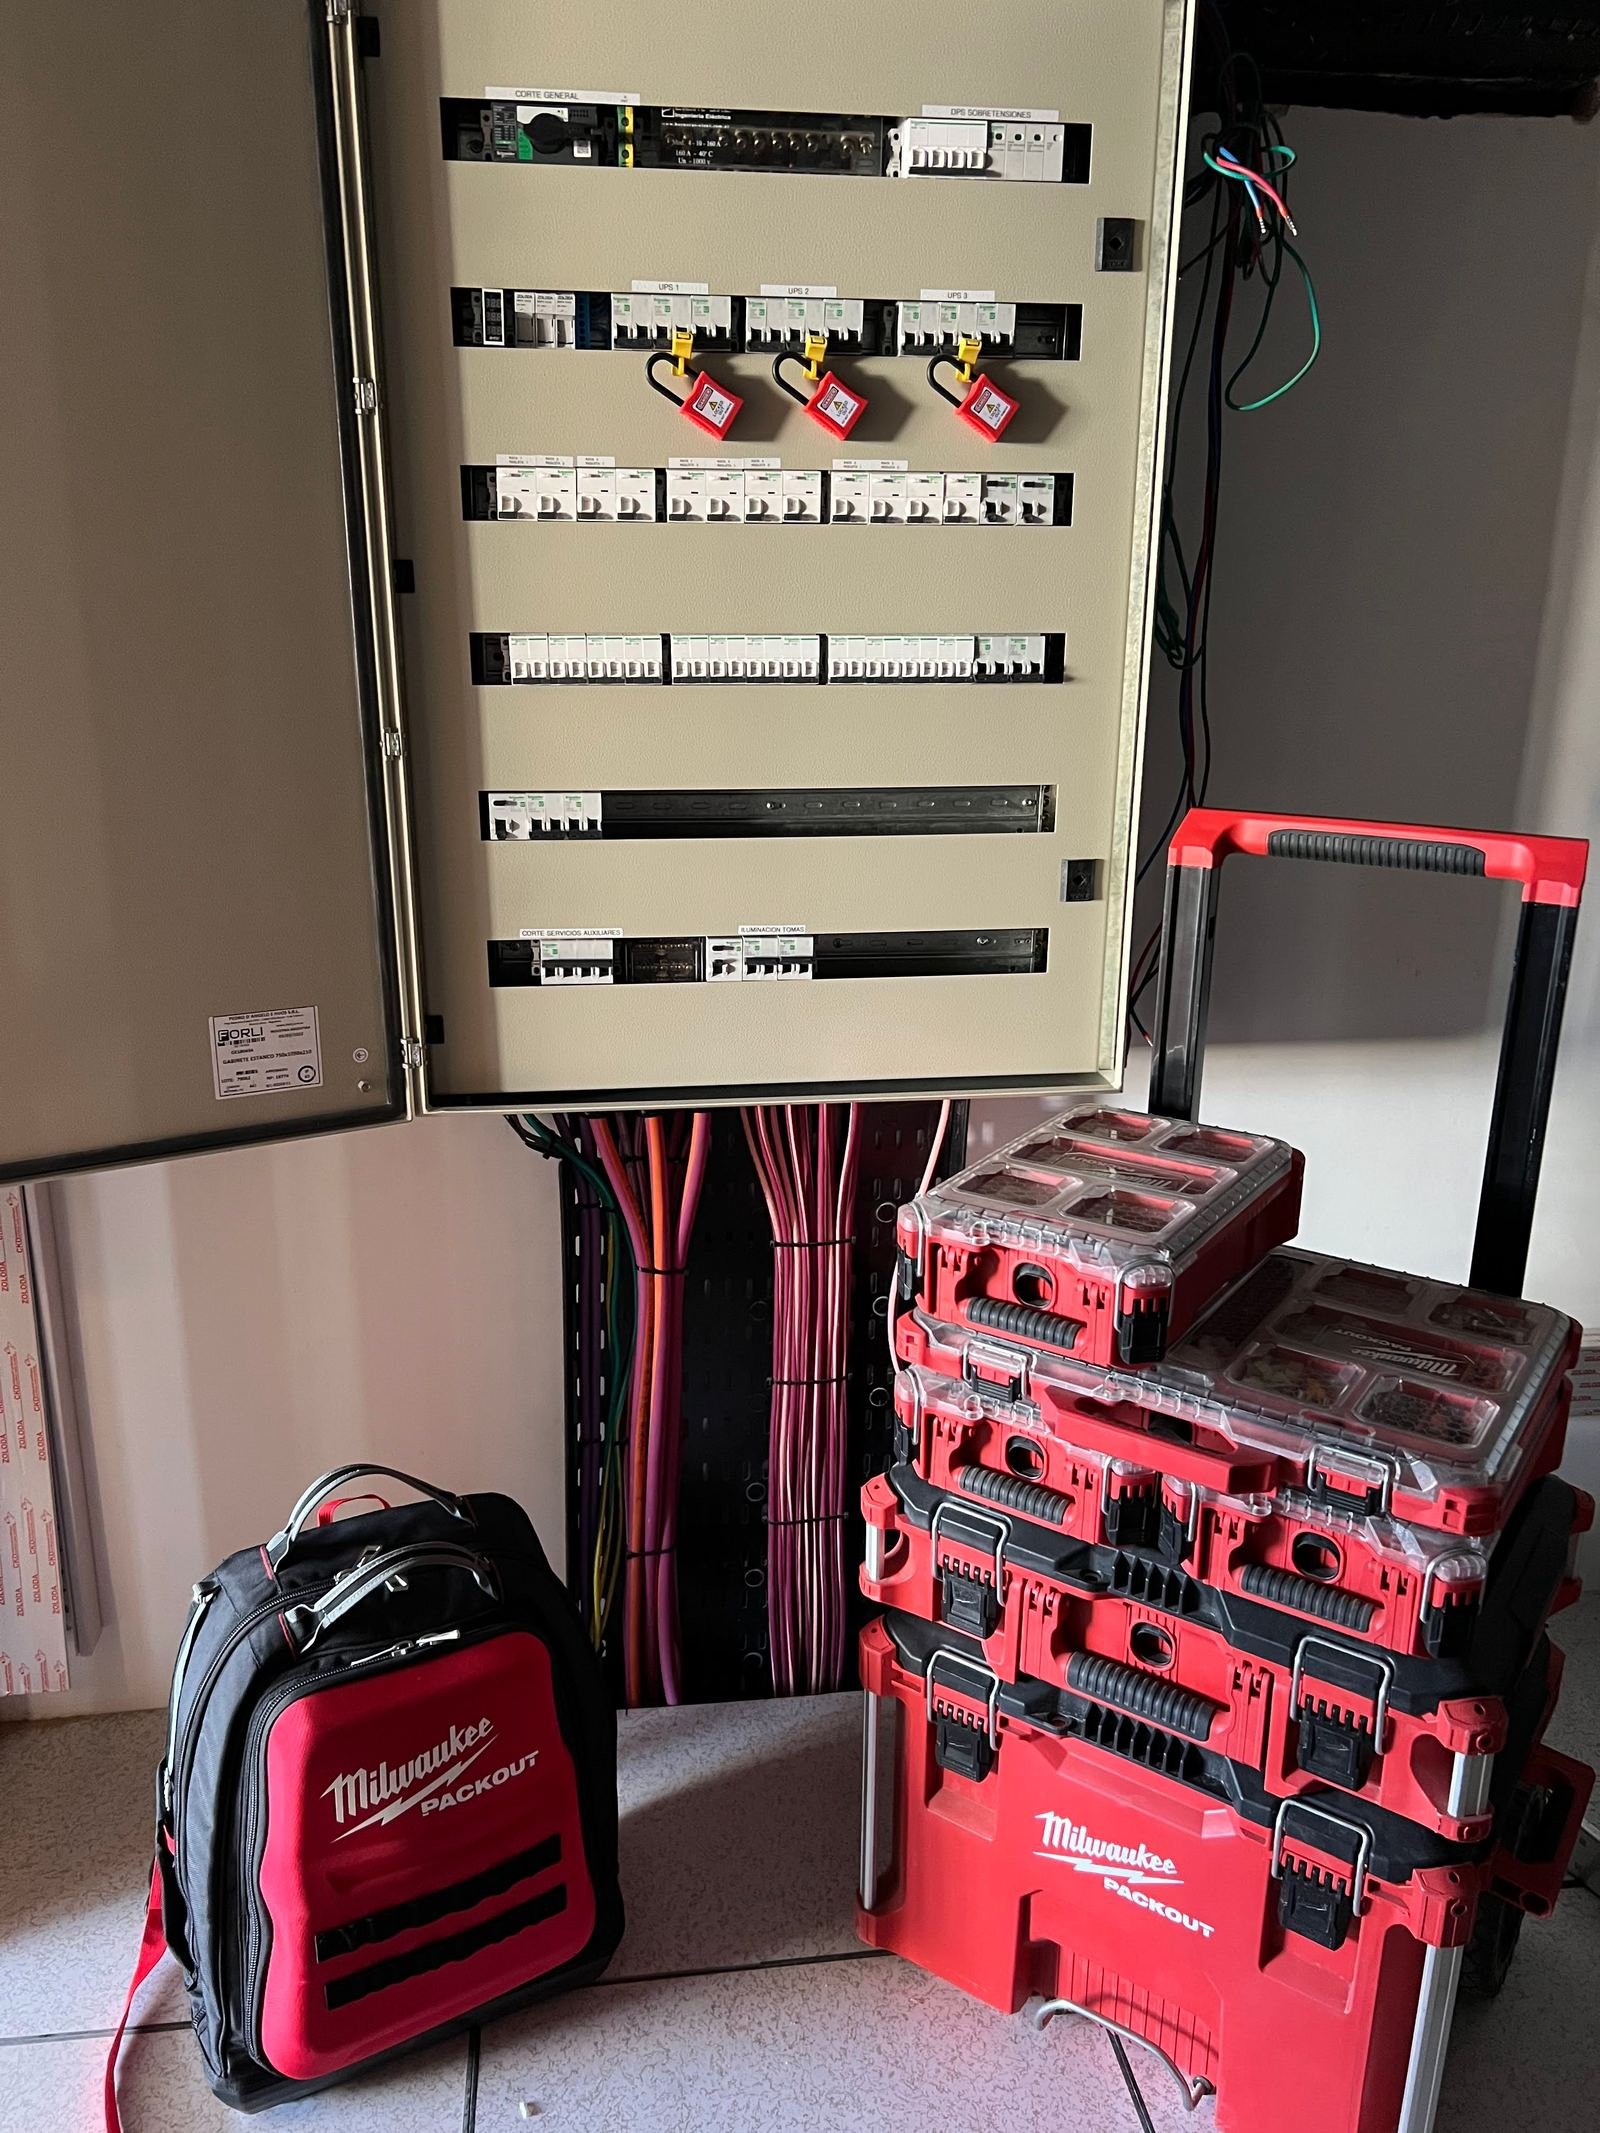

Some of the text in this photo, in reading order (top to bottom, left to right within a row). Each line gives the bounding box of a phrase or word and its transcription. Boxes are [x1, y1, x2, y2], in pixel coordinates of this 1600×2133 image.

[515, 89, 579, 100] CORTE GENERAL
[950, 108, 1032, 119] DPS SOBRETENSIONES
[658, 283, 673, 292] UPS
[788, 287, 810, 295] UPS 2
[947, 291, 968, 300] UPS 3
[217, 1027, 263, 1042] FORLI
[0, 1260, 9, 1292] ZOLODA
[20, 1273, 29, 1304] ZOLODA
[1351, 1348, 1460, 1376] Milwaukee
[33, 1396, 41, 1412] CKD
[1, 1433, 10, 1464] ZOLODA
[18, 1420, 27, 1450] ZOLODA
[37, 1431, 47, 1461] ZOLODA
[48, 1550, 56, 1567] CKD
[15, 1587, 24, 1617] ZOLODA
[32, 1573, 41, 1603] ZOLODA
[51, 1585, 60, 1614] ZOLODA
[320, 1717, 494, 1824] Milwaukee
[421, 1750, 540, 1817] PACKOUT
[1034, 1810, 1178, 1875] Milwaukee
[1103, 1876, 1215, 1938] PACKOUT
